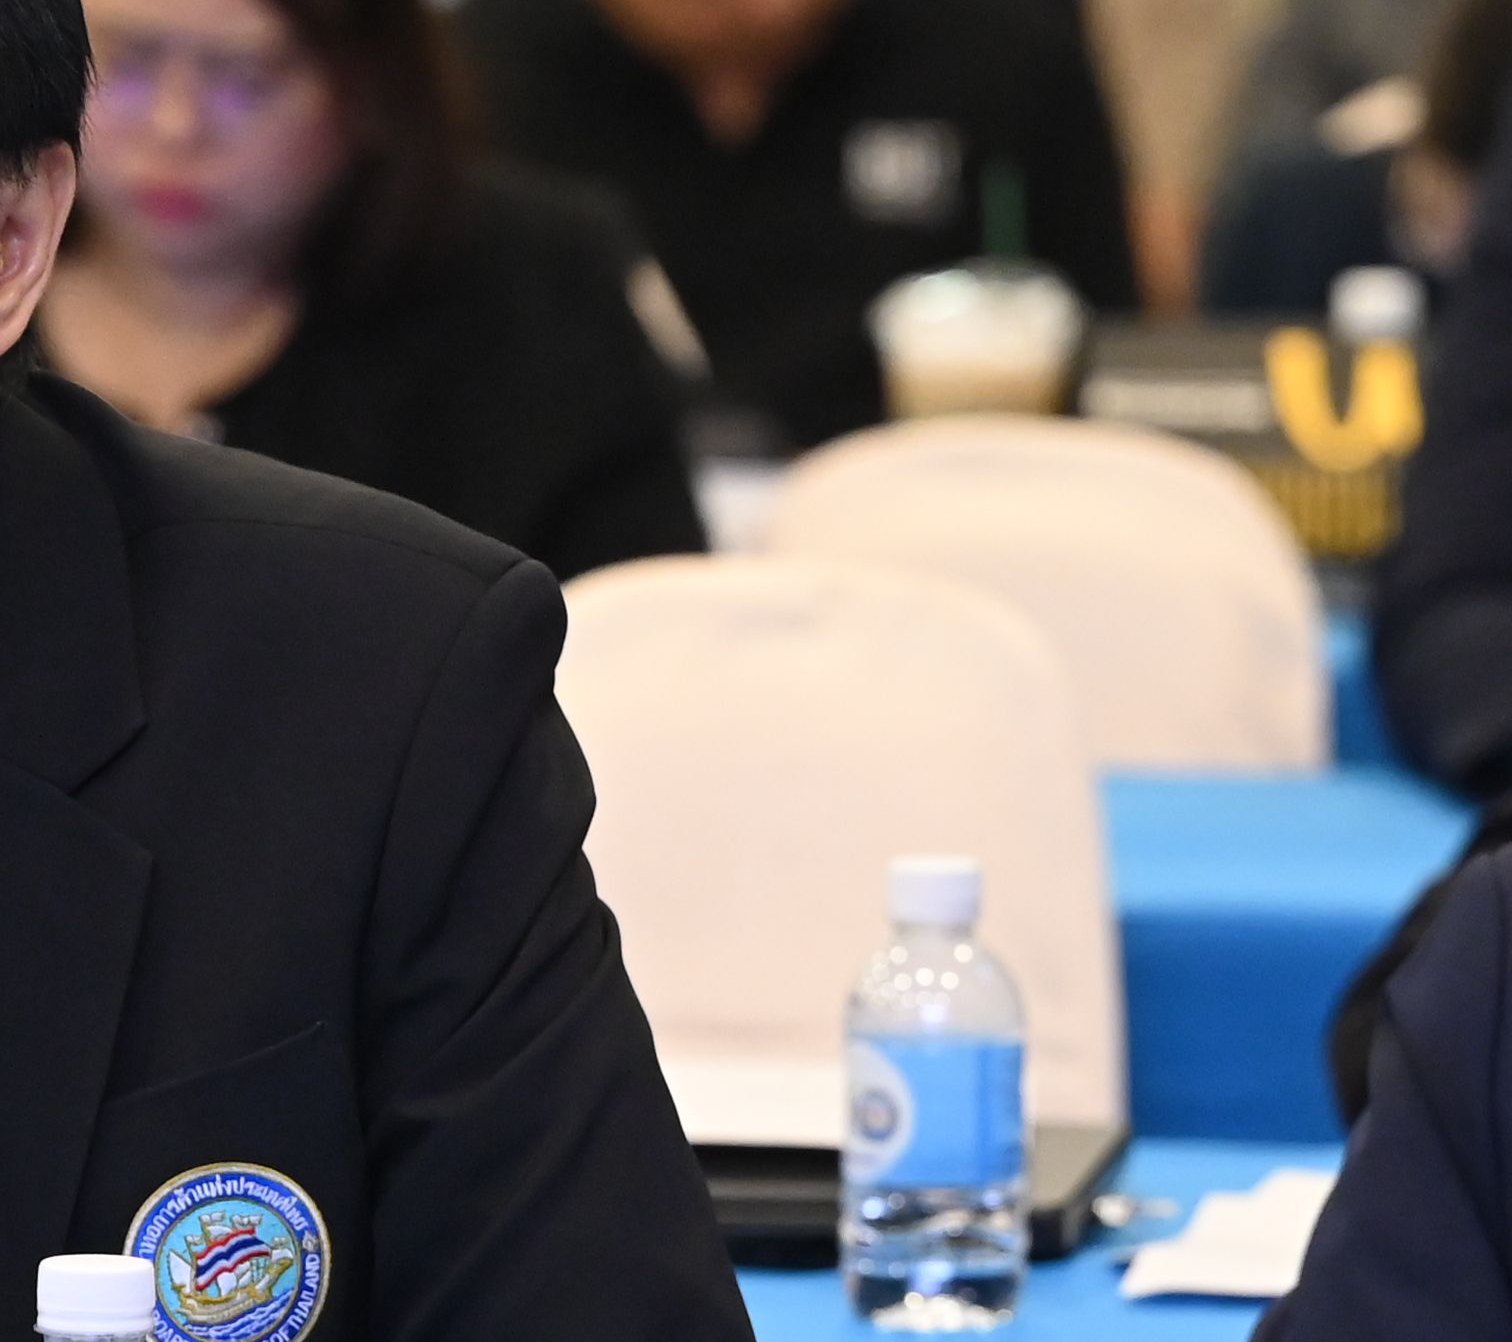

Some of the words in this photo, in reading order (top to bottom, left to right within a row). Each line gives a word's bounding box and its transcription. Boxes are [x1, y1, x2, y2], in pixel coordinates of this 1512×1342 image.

[139, 1174, 309, 1258] าหอการค้าแห่งประเทศไทย
[287, 1252, 320, 1331] THAILAND
